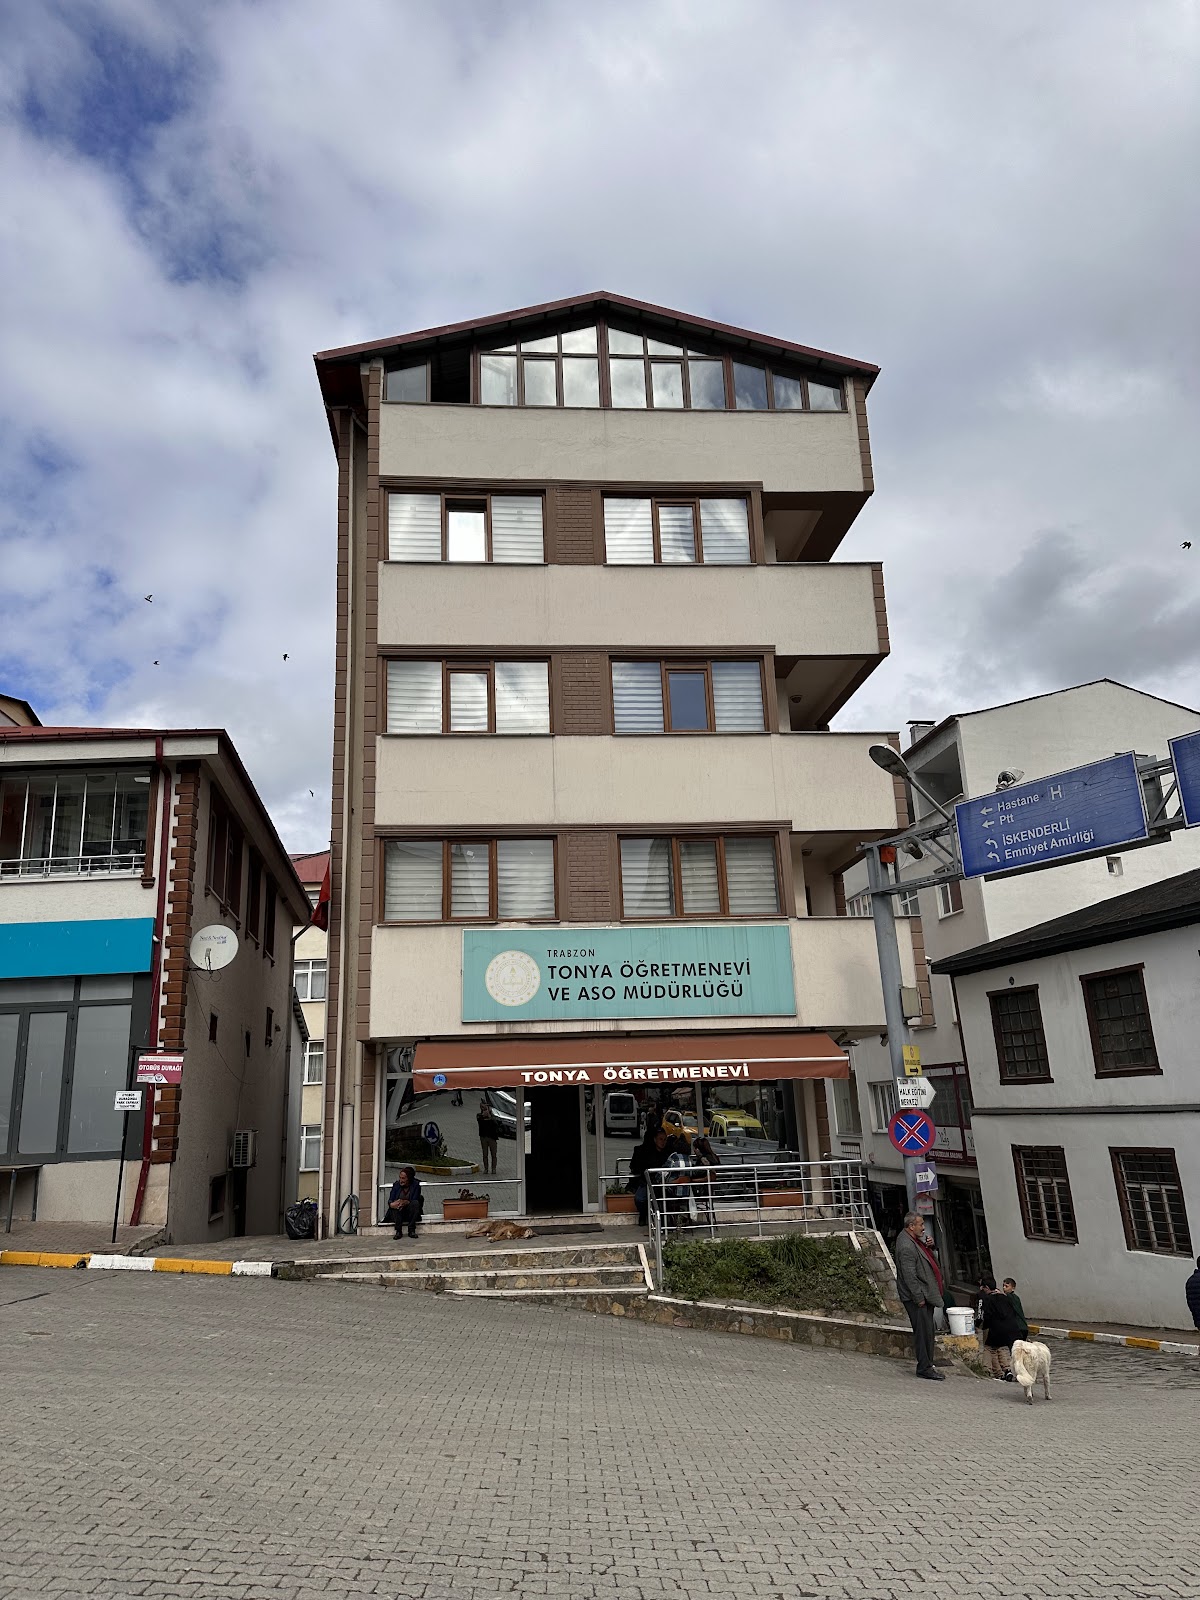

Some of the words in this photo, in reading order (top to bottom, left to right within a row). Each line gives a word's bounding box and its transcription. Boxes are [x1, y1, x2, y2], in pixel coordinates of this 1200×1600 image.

[997, 792, 1040, 812] Hastane
[999, 812, 1015, 826] Ptt
[1002, 817, 1070, 846] İSKENDERLİ
[1004, 840, 1049, 861] Emniyet
[1050, 828, 1095, 849] Amirliği
[547, 949, 596, 958] TRABZON
[548, 964, 613, 980] TONYA
[620, 959, 751, 978] ÖĞRETMENEVİ
[547, 986, 570, 1001] VE
[577, 984, 616, 1001] ASO
[623, 979, 744, 1000] MÜDÜRLÜĞÜ
[521, 1069, 590, 1083] TONYA
[603, 1063, 750, 1082] ÖĞRETMENEVİ
[899, 1088, 911, 1096] HALK
